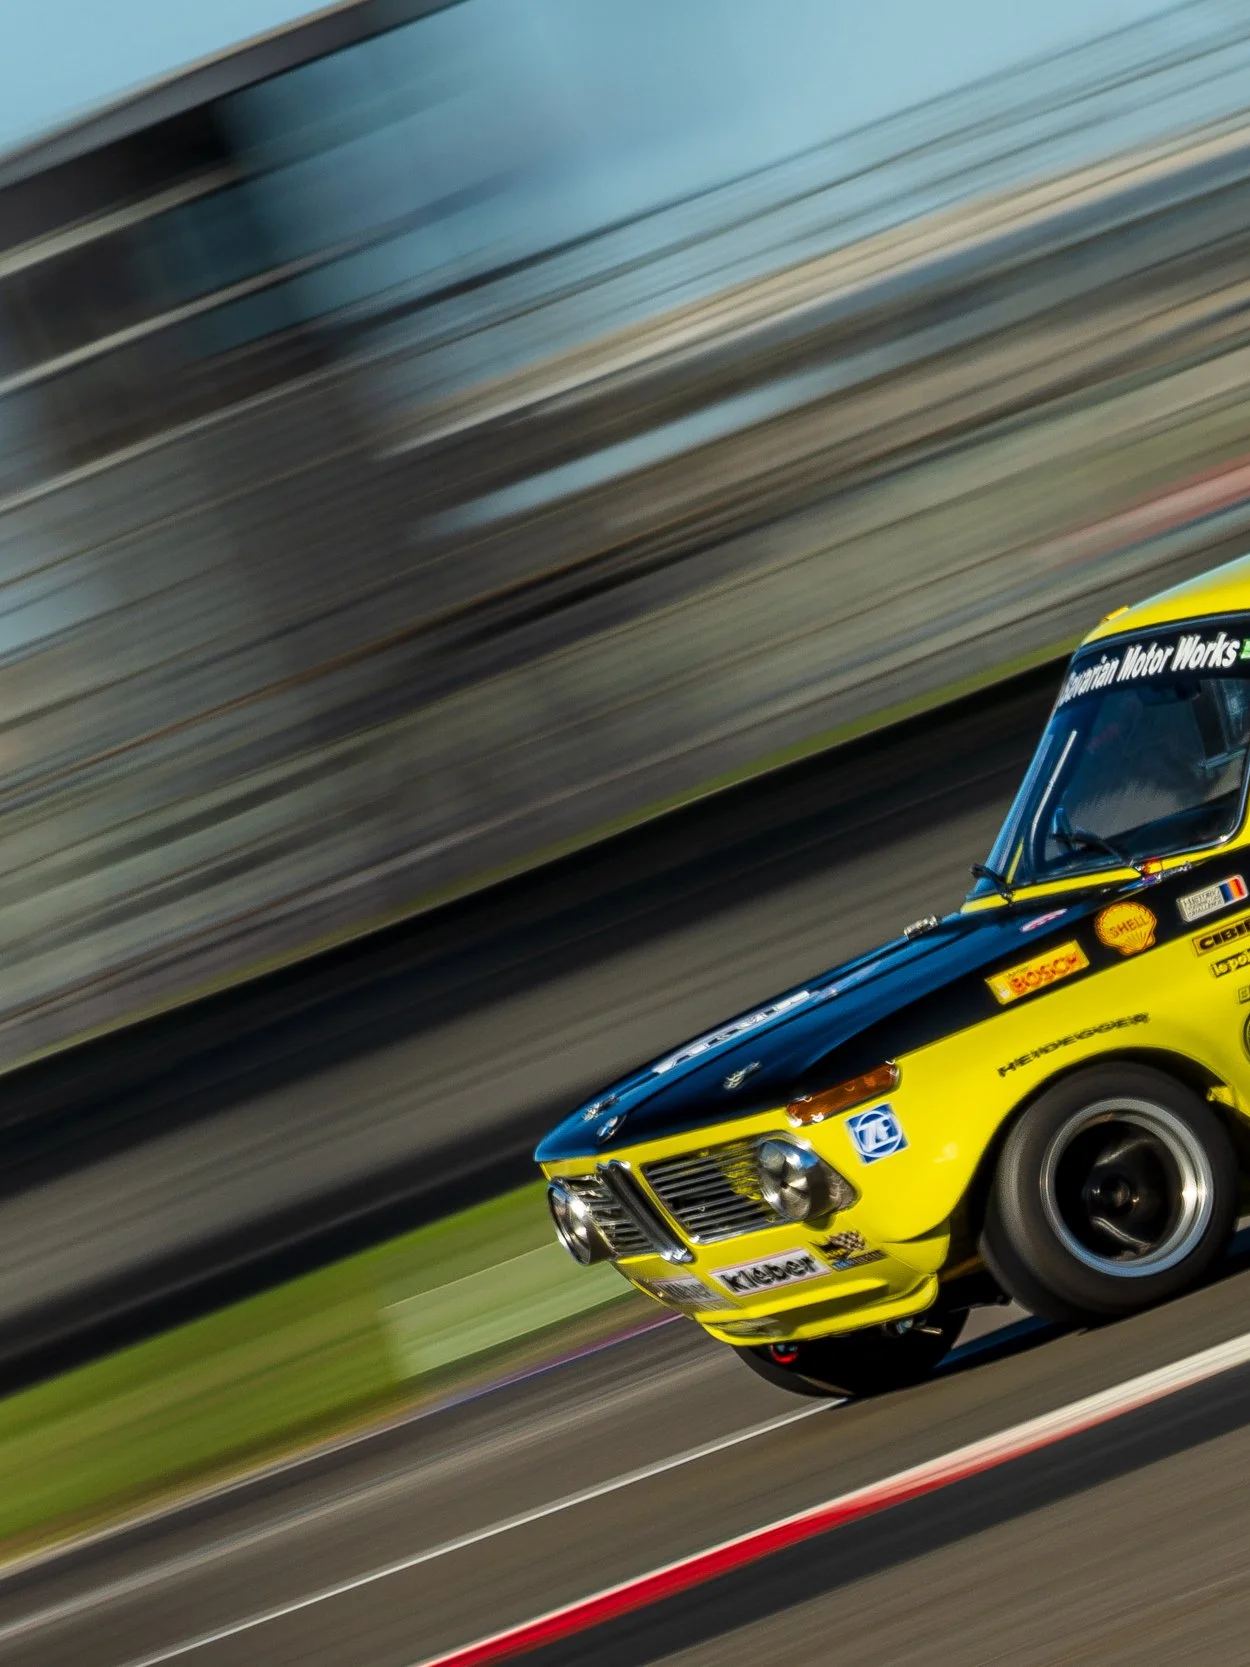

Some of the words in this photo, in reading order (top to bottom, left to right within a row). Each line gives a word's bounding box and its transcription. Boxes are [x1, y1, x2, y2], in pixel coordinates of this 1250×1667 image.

[1116, 643, 1175, 682] Motor
[1169, 631, 1241, 672] Works
[1109, 914, 1149, 939] SHELL
[1009, 951, 1081, 996] BOSCH
[857, 1115, 899, 1152] ZF
